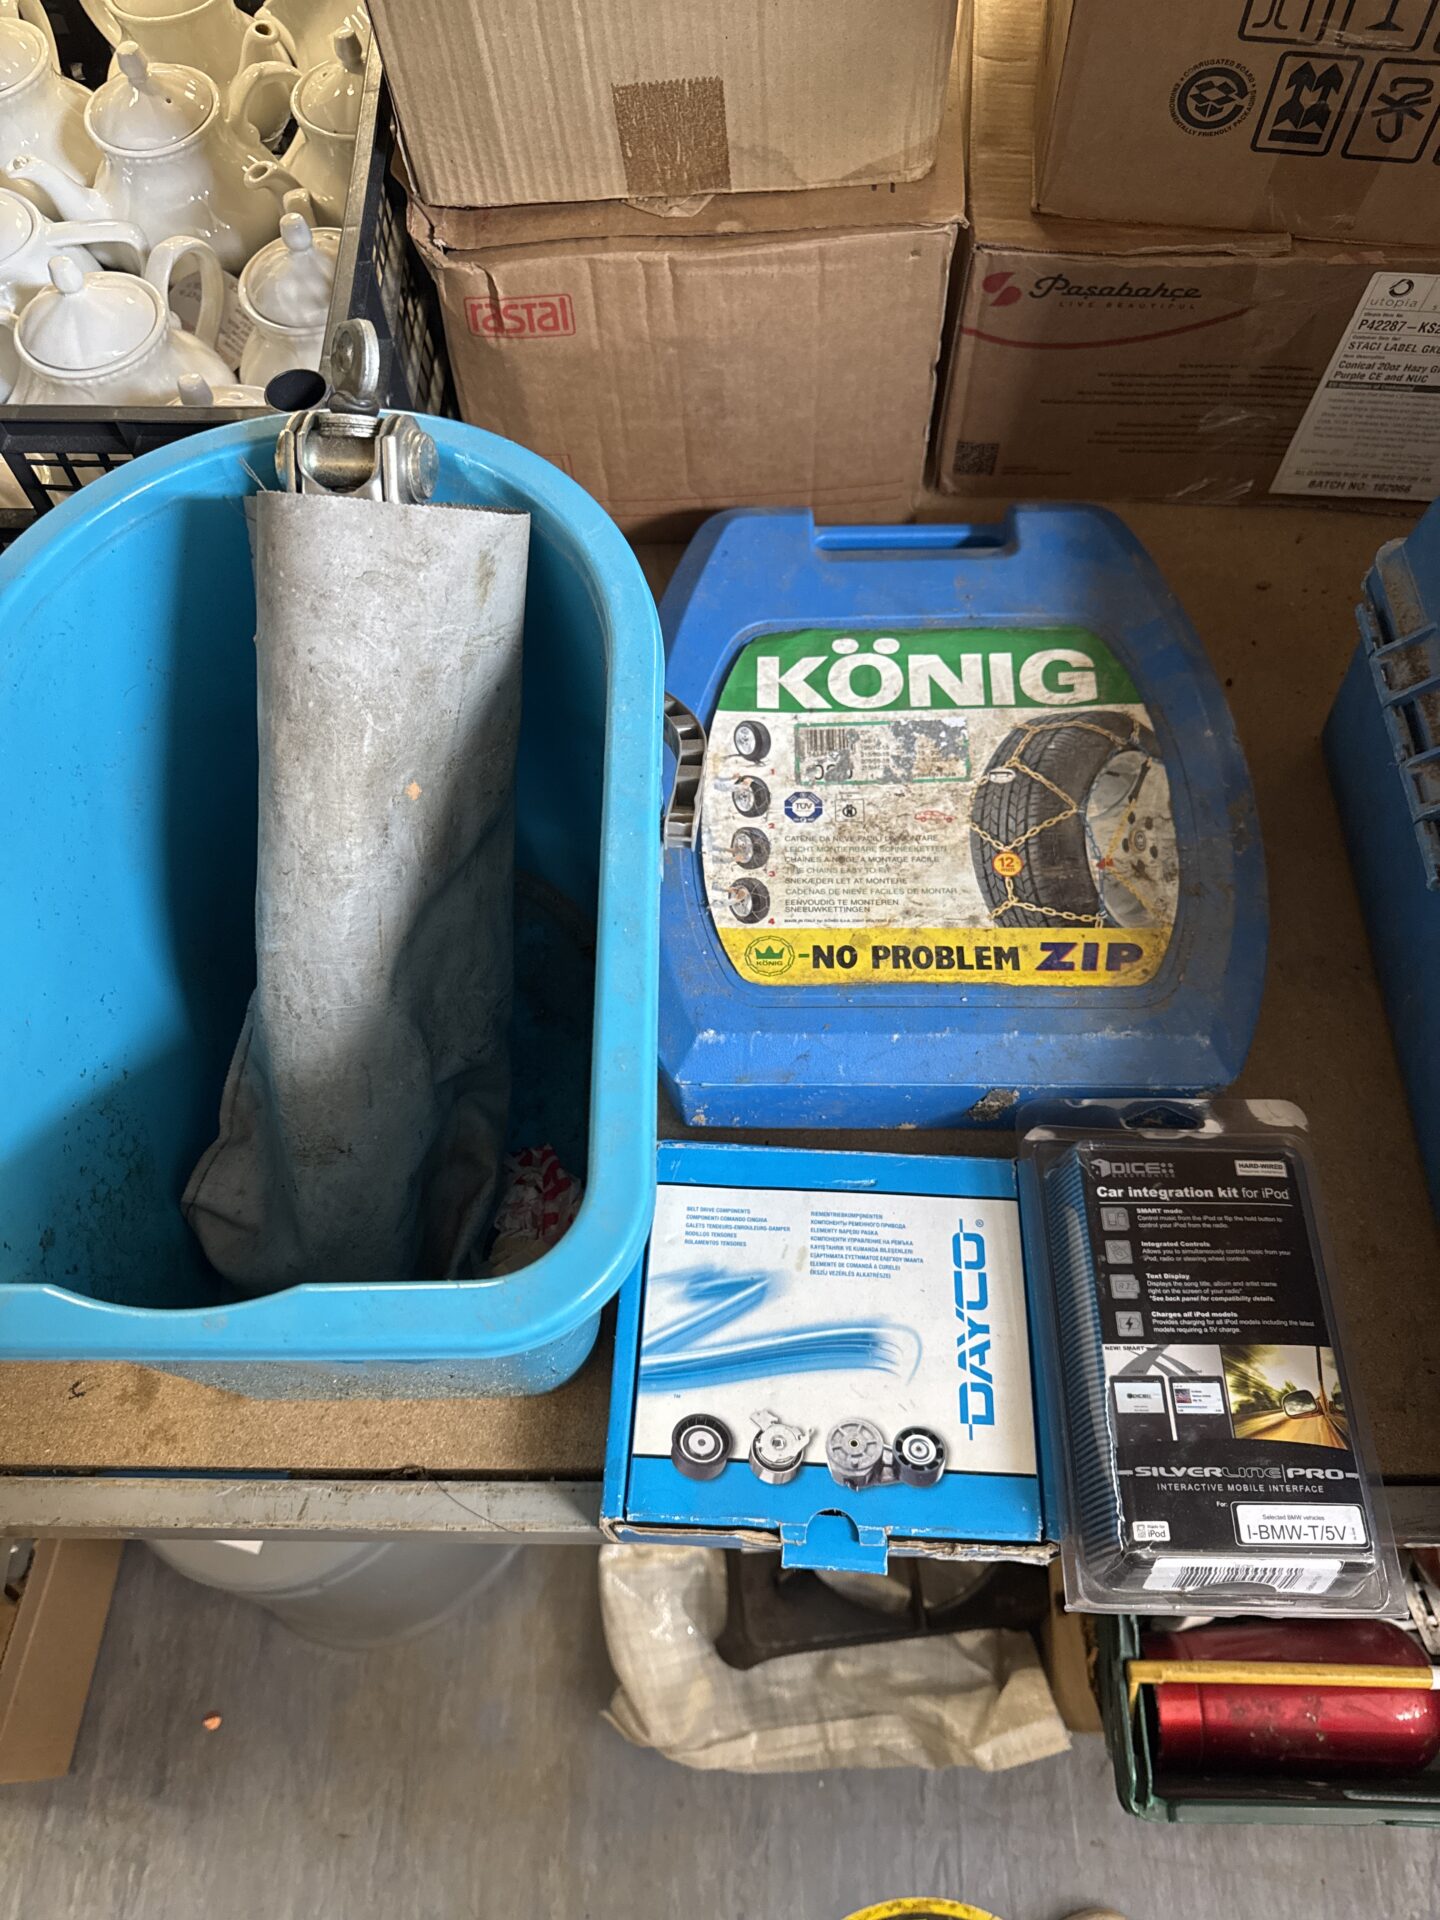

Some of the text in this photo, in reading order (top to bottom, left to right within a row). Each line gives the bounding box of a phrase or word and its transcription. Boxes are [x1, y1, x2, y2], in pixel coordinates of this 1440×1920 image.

[1370, 298, 1418, 308] utopia
[470, 297, 569, 334] rastal
[1348, 342, 1416, 352] STACI LABEL
[1338, 360, 1428, 374] Conical 20oz Hazy
[1334, 371, 1366, 380] Purple
[1369, 372, 1383, 380] CE
[1406, 375, 1428, 383] NUC
[1308, 480, 1345, 489] BATCH
[756, 638, 1098, 709] KÖNIG
[998, 857, 1014, 867] 12
[813, 942, 1144, 971] NO PROBLEM ZIP
[1112, 1162, 1160, 1174] DICE
[1097, 1186, 1289, 1200] Car integration kit for iPod
[952, 1218, 995, 1441] DAYCO
[1286, 1468, 1344, 1480] PRO
[1157, 1483, 1324, 1493] INTERACTIVE MOBILE INTERFACE
[1148, 1529, 1166, 1538] iPod
[1247, 1524, 1346, 1540] I-BMW-T/5V
